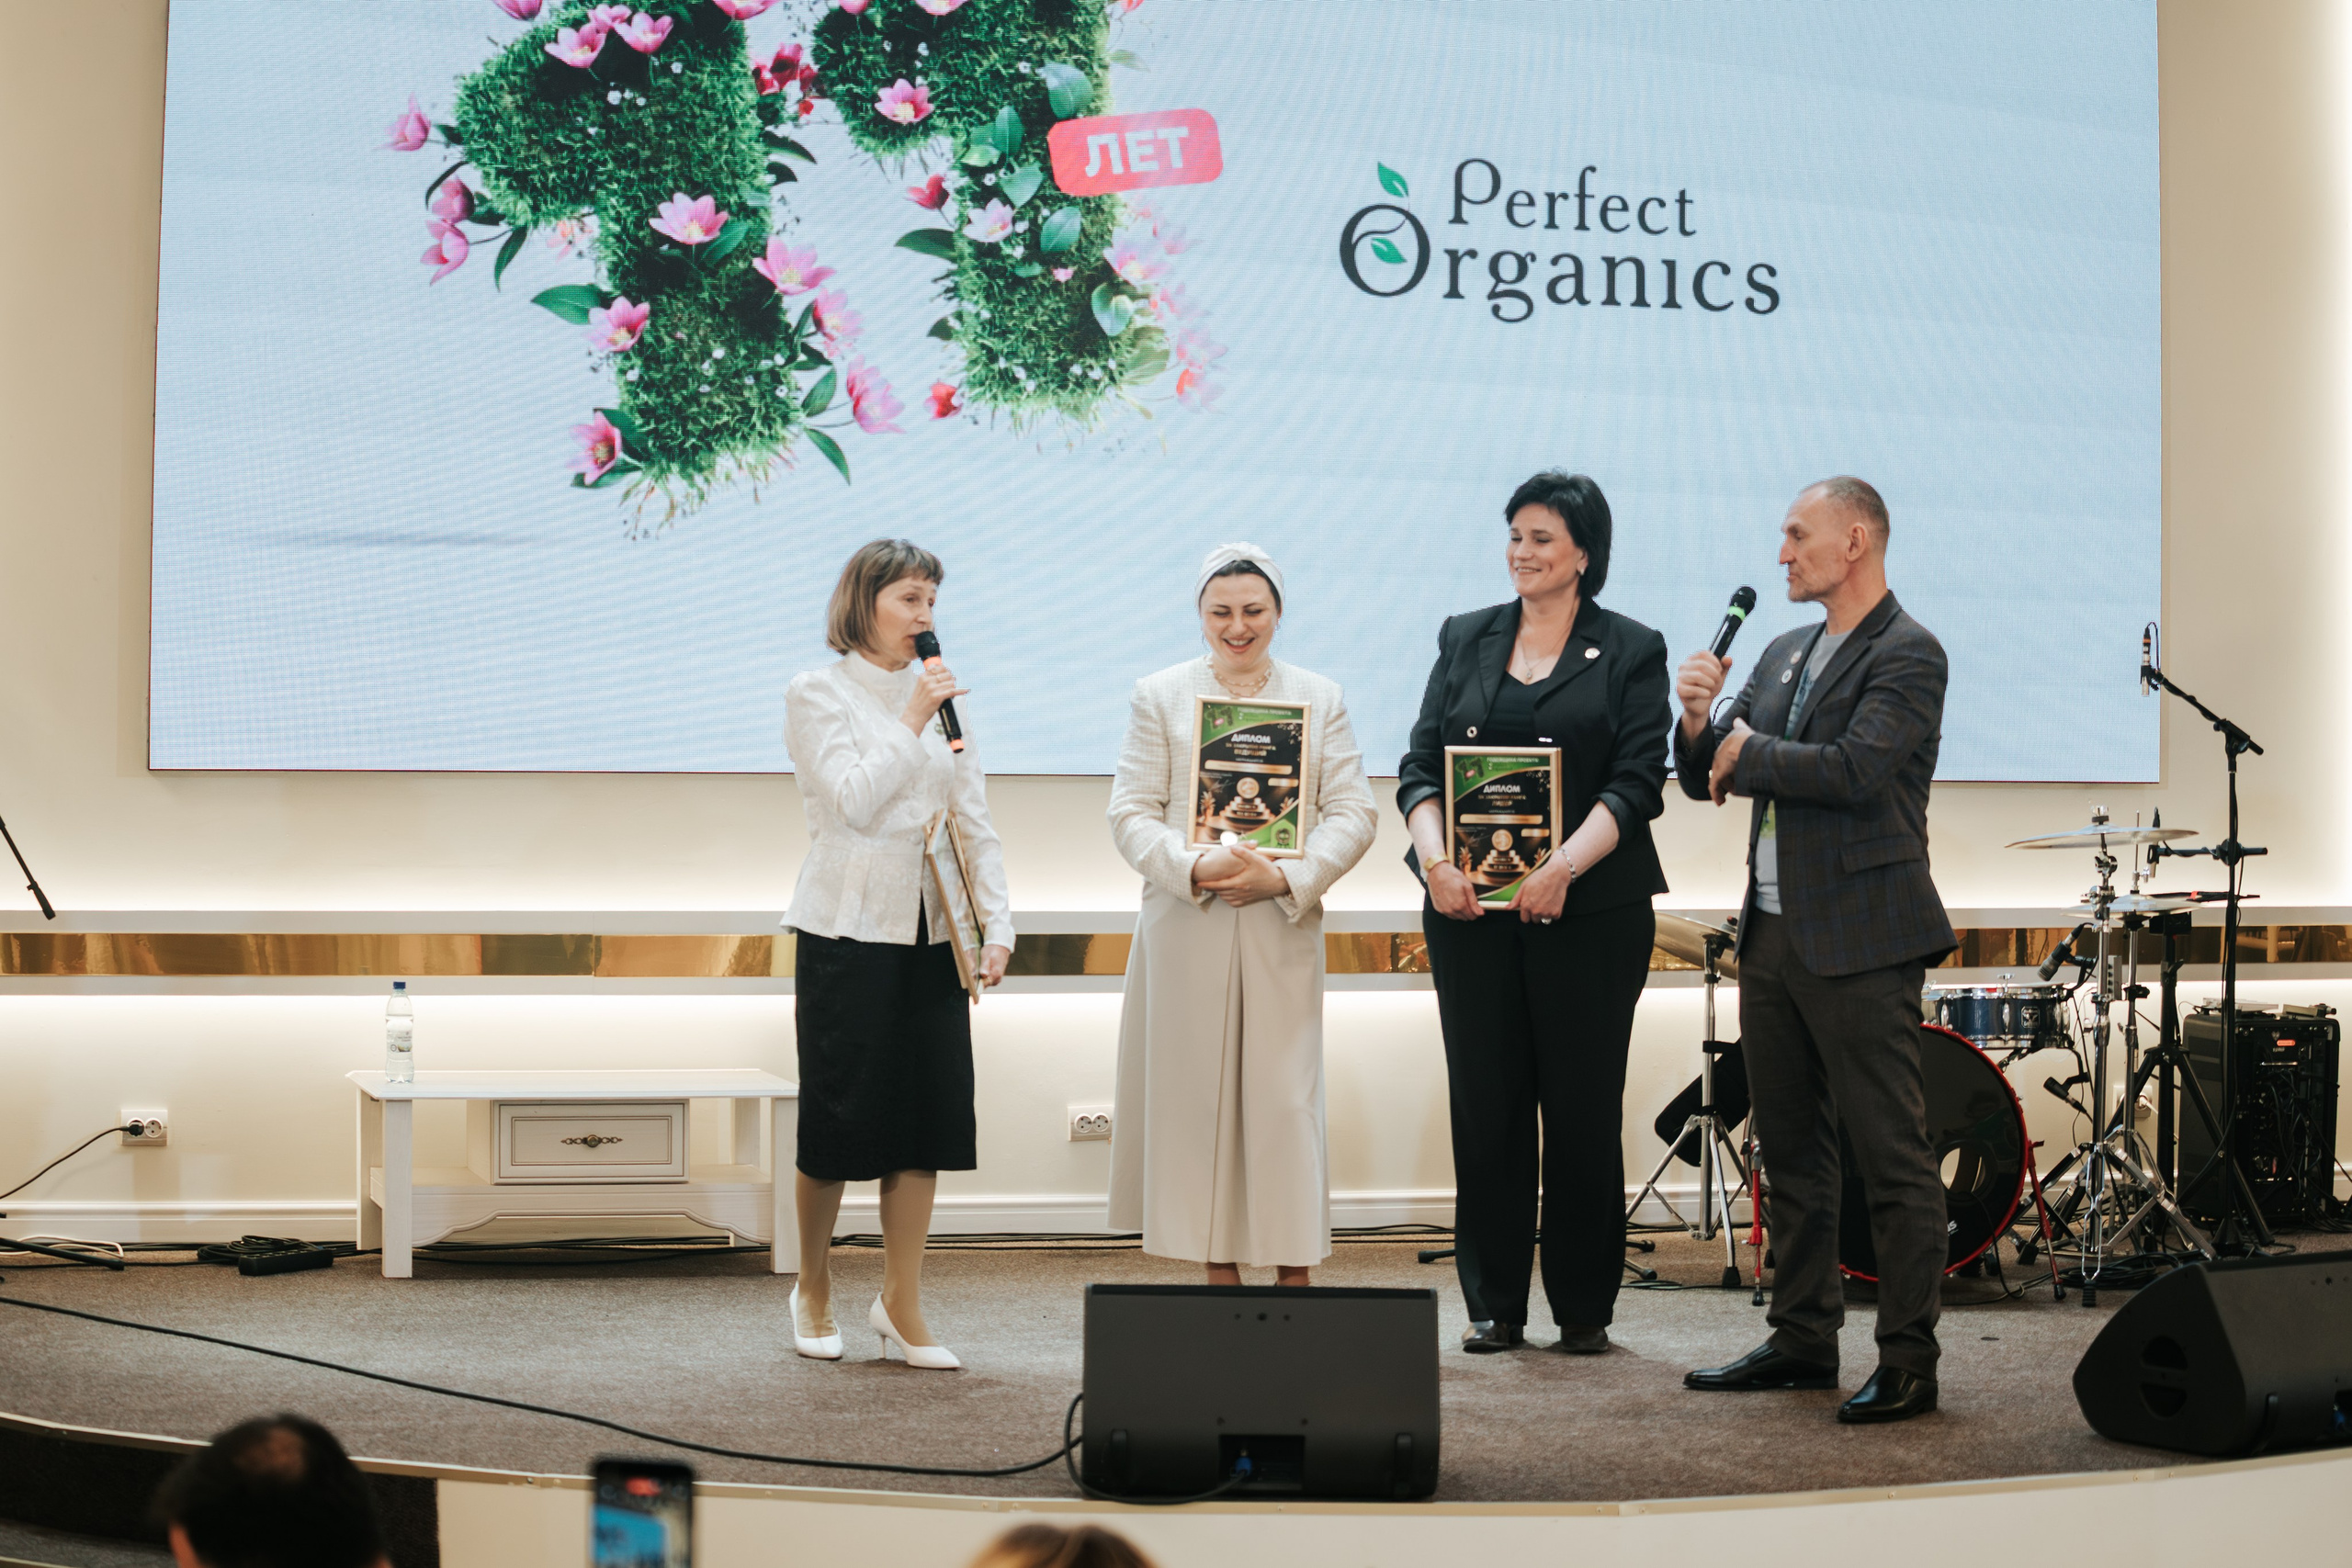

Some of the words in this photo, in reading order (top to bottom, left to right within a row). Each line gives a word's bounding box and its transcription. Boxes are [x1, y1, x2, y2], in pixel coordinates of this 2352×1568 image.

[1083, 126, 1190, 178] ЛЕТ
[1447, 157, 1697, 237] Perfect
[1339, 203, 1781, 323] Organics
[1231, 733, 1271, 744] ДИПЛОМ
[1483, 784, 1521, 794] ДИПЛОМ
